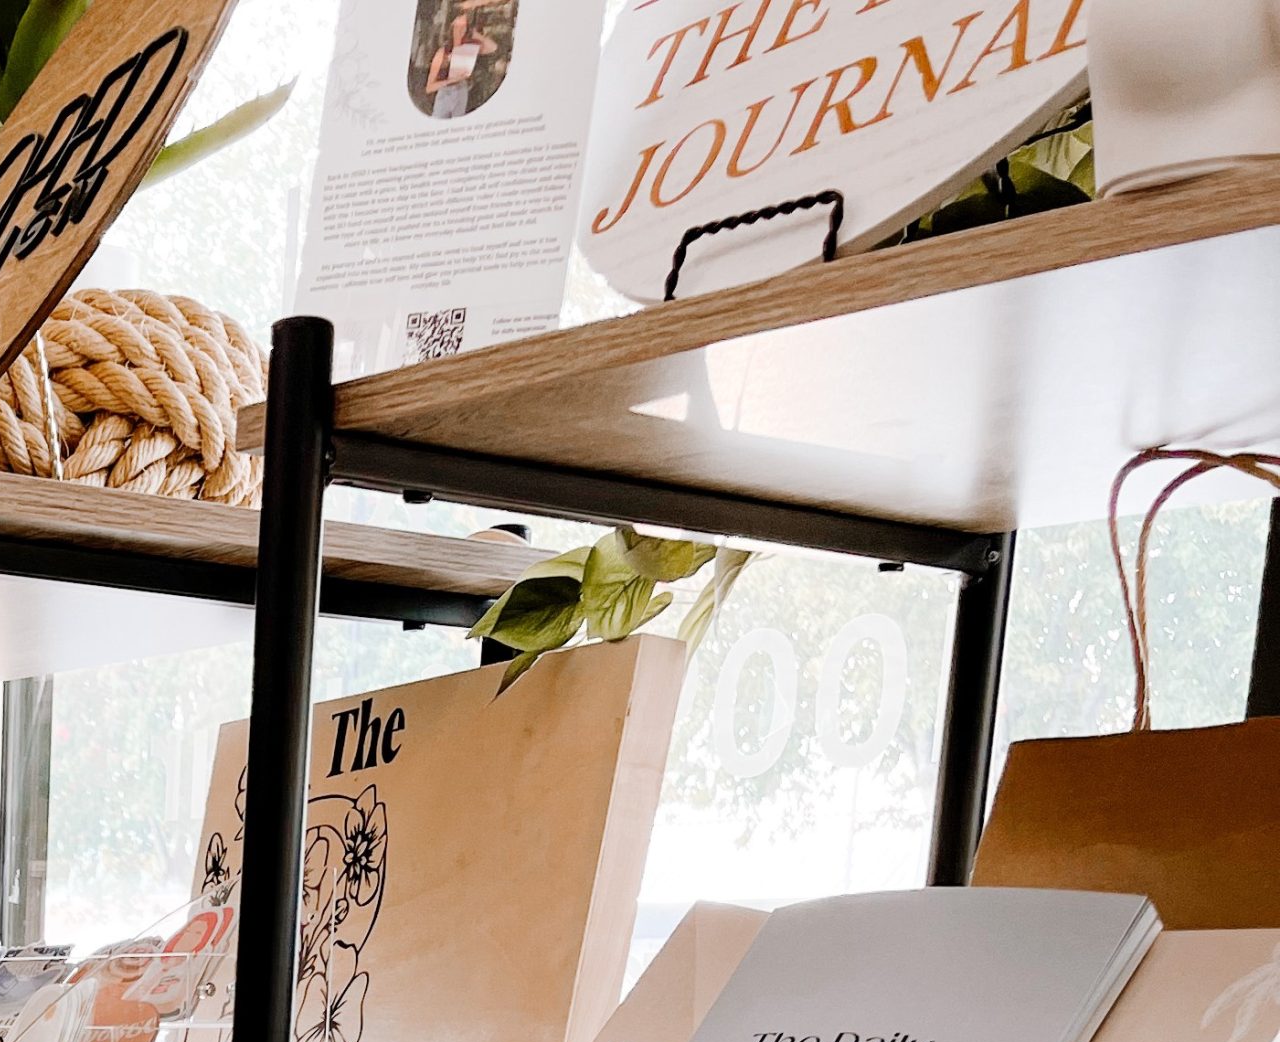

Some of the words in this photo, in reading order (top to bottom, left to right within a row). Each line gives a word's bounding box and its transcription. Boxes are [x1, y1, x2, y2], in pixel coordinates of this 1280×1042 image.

[635, 0, 831, 109] THE
[592, 0, 1087, 233] JOURNAL
[327, 698, 406, 778] The
